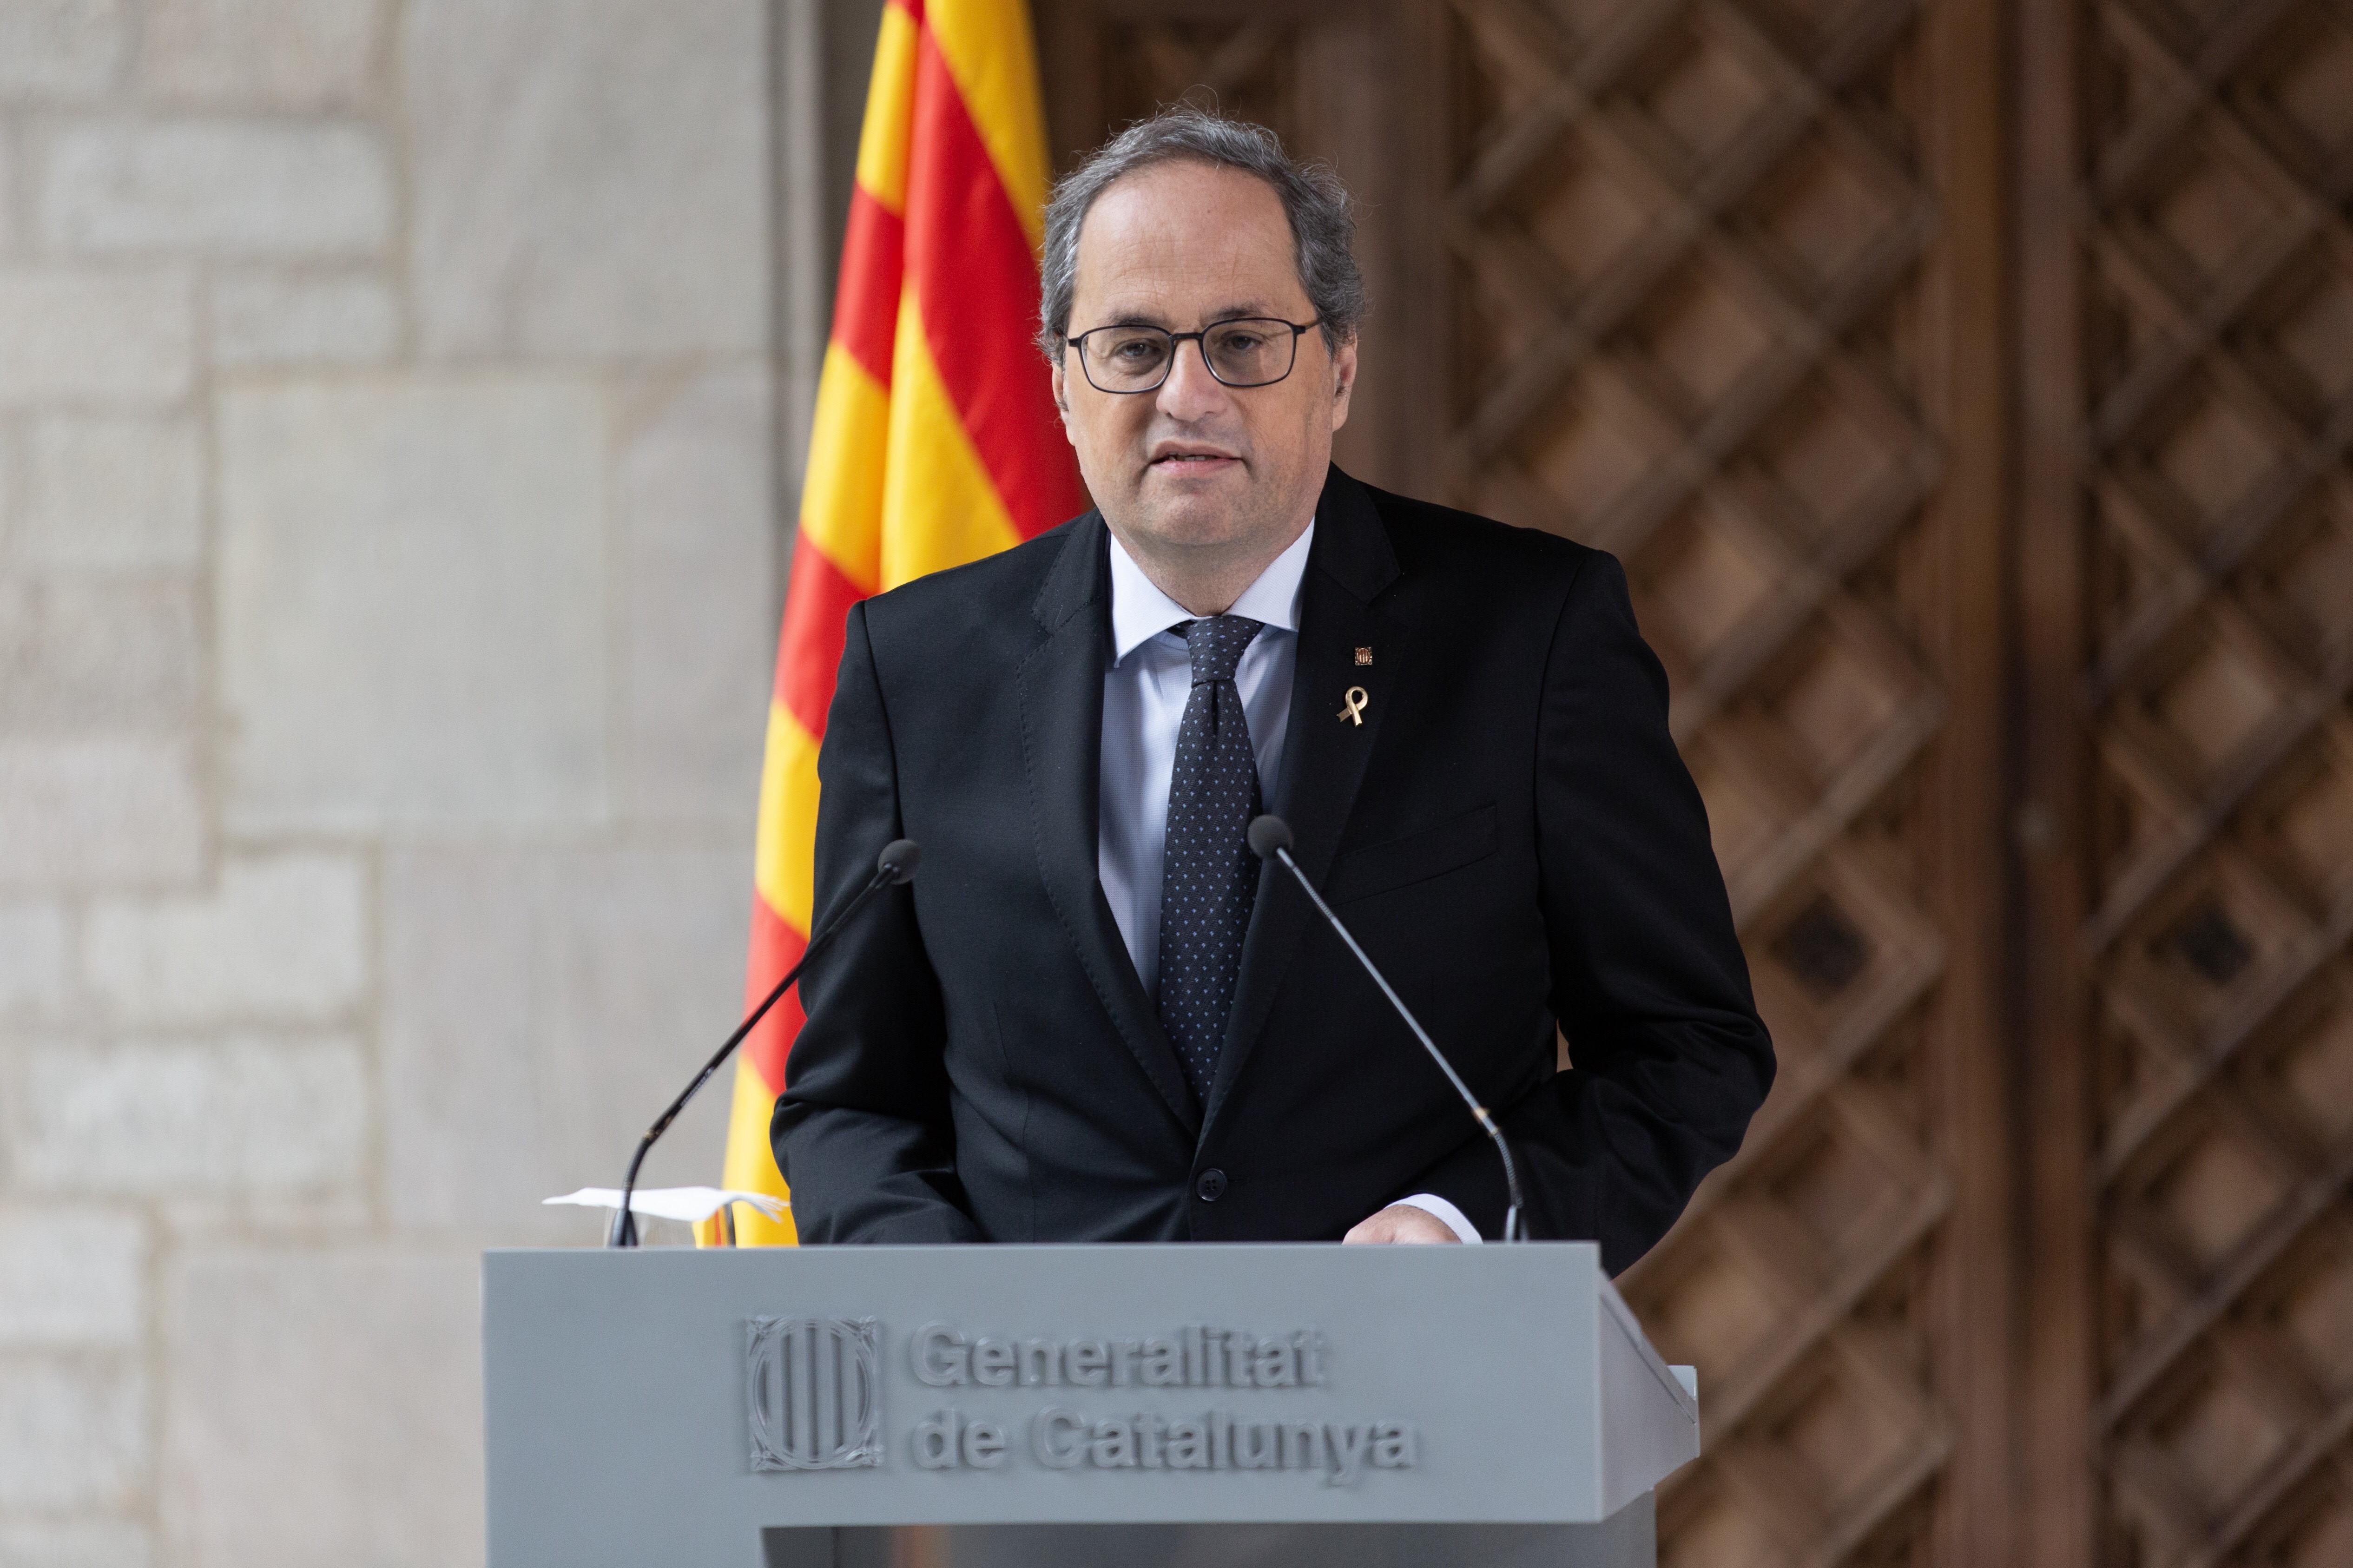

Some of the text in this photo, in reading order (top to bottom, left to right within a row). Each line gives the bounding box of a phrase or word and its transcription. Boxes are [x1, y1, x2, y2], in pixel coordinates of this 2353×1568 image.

[910, 1323, 1325, 1387] Generalitat
[914, 1407, 1415, 1481] de Catalunya
